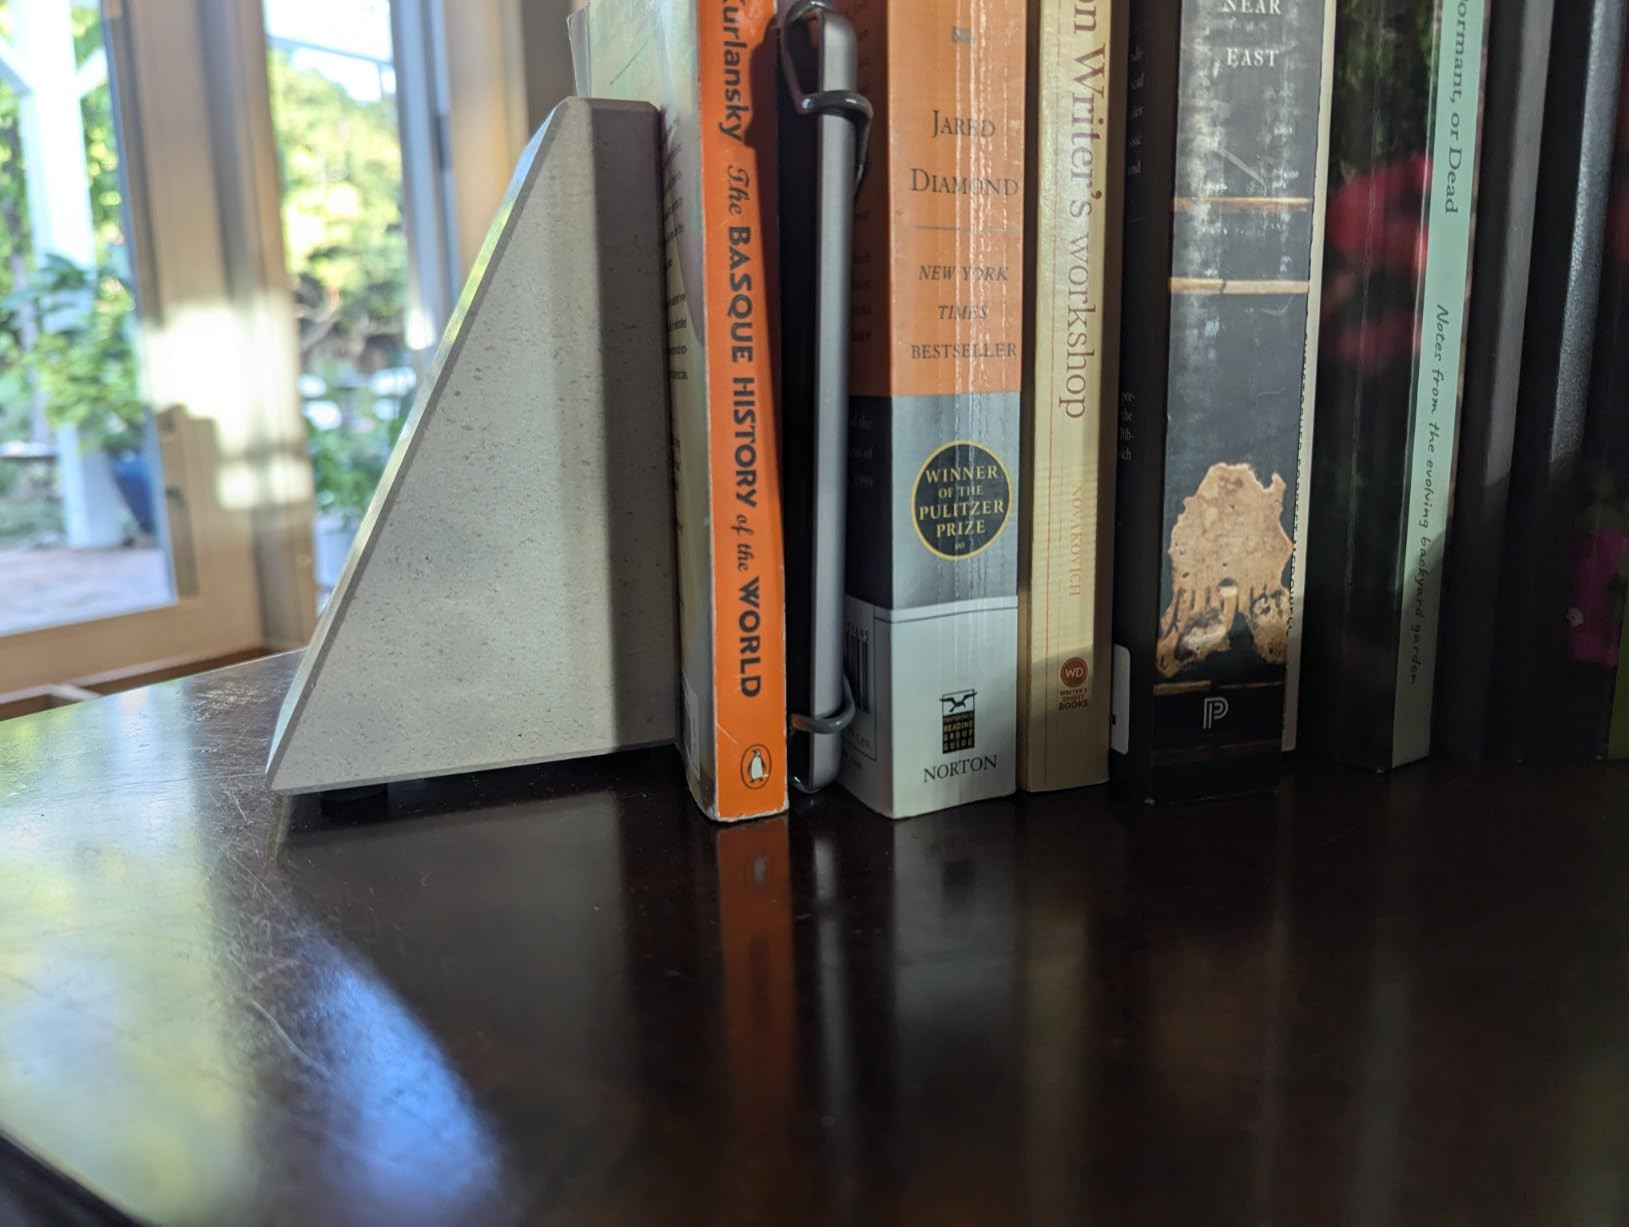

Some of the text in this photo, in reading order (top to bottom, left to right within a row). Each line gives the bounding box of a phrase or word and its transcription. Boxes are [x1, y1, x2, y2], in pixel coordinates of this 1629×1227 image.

[1222, 0, 1281, 15] NEAR
[1226, 47, 1280, 67] EAST
[1445, 0, 1469, 216] ormant, or Dead
[727, 164, 751, 217] The
[918, 265, 1009, 282] NEW YORK
[727, 226, 754, 363] BASQUE
[938, 305, 988, 321] TIMES
[1059, 234, 1096, 419] workshop
[911, 343, 1017, 360] BESTSELLER
[731, 376, 758, 507] HISTORY
[924, 464, 998, 484] WINNER
[938, 483, 984, 499] OF THE
[1409, 303, 1449, 686] Notes from the evolving backyard garden
[919, 499, 1004, 521] PULITZER
[730, 513, 753, 538] of
[936, 520, 986, 539] PRIZE
[1069, 484, 1083, 598] NOVAKOVICH
[736, 543, 760, 572] the
[738, 575, 762, 699] WORLD
[1065, 667, 1084, 678] WD
[1058, 699, 1088, 711] BOOKS
[923, 754, 997, 783] NORTON
